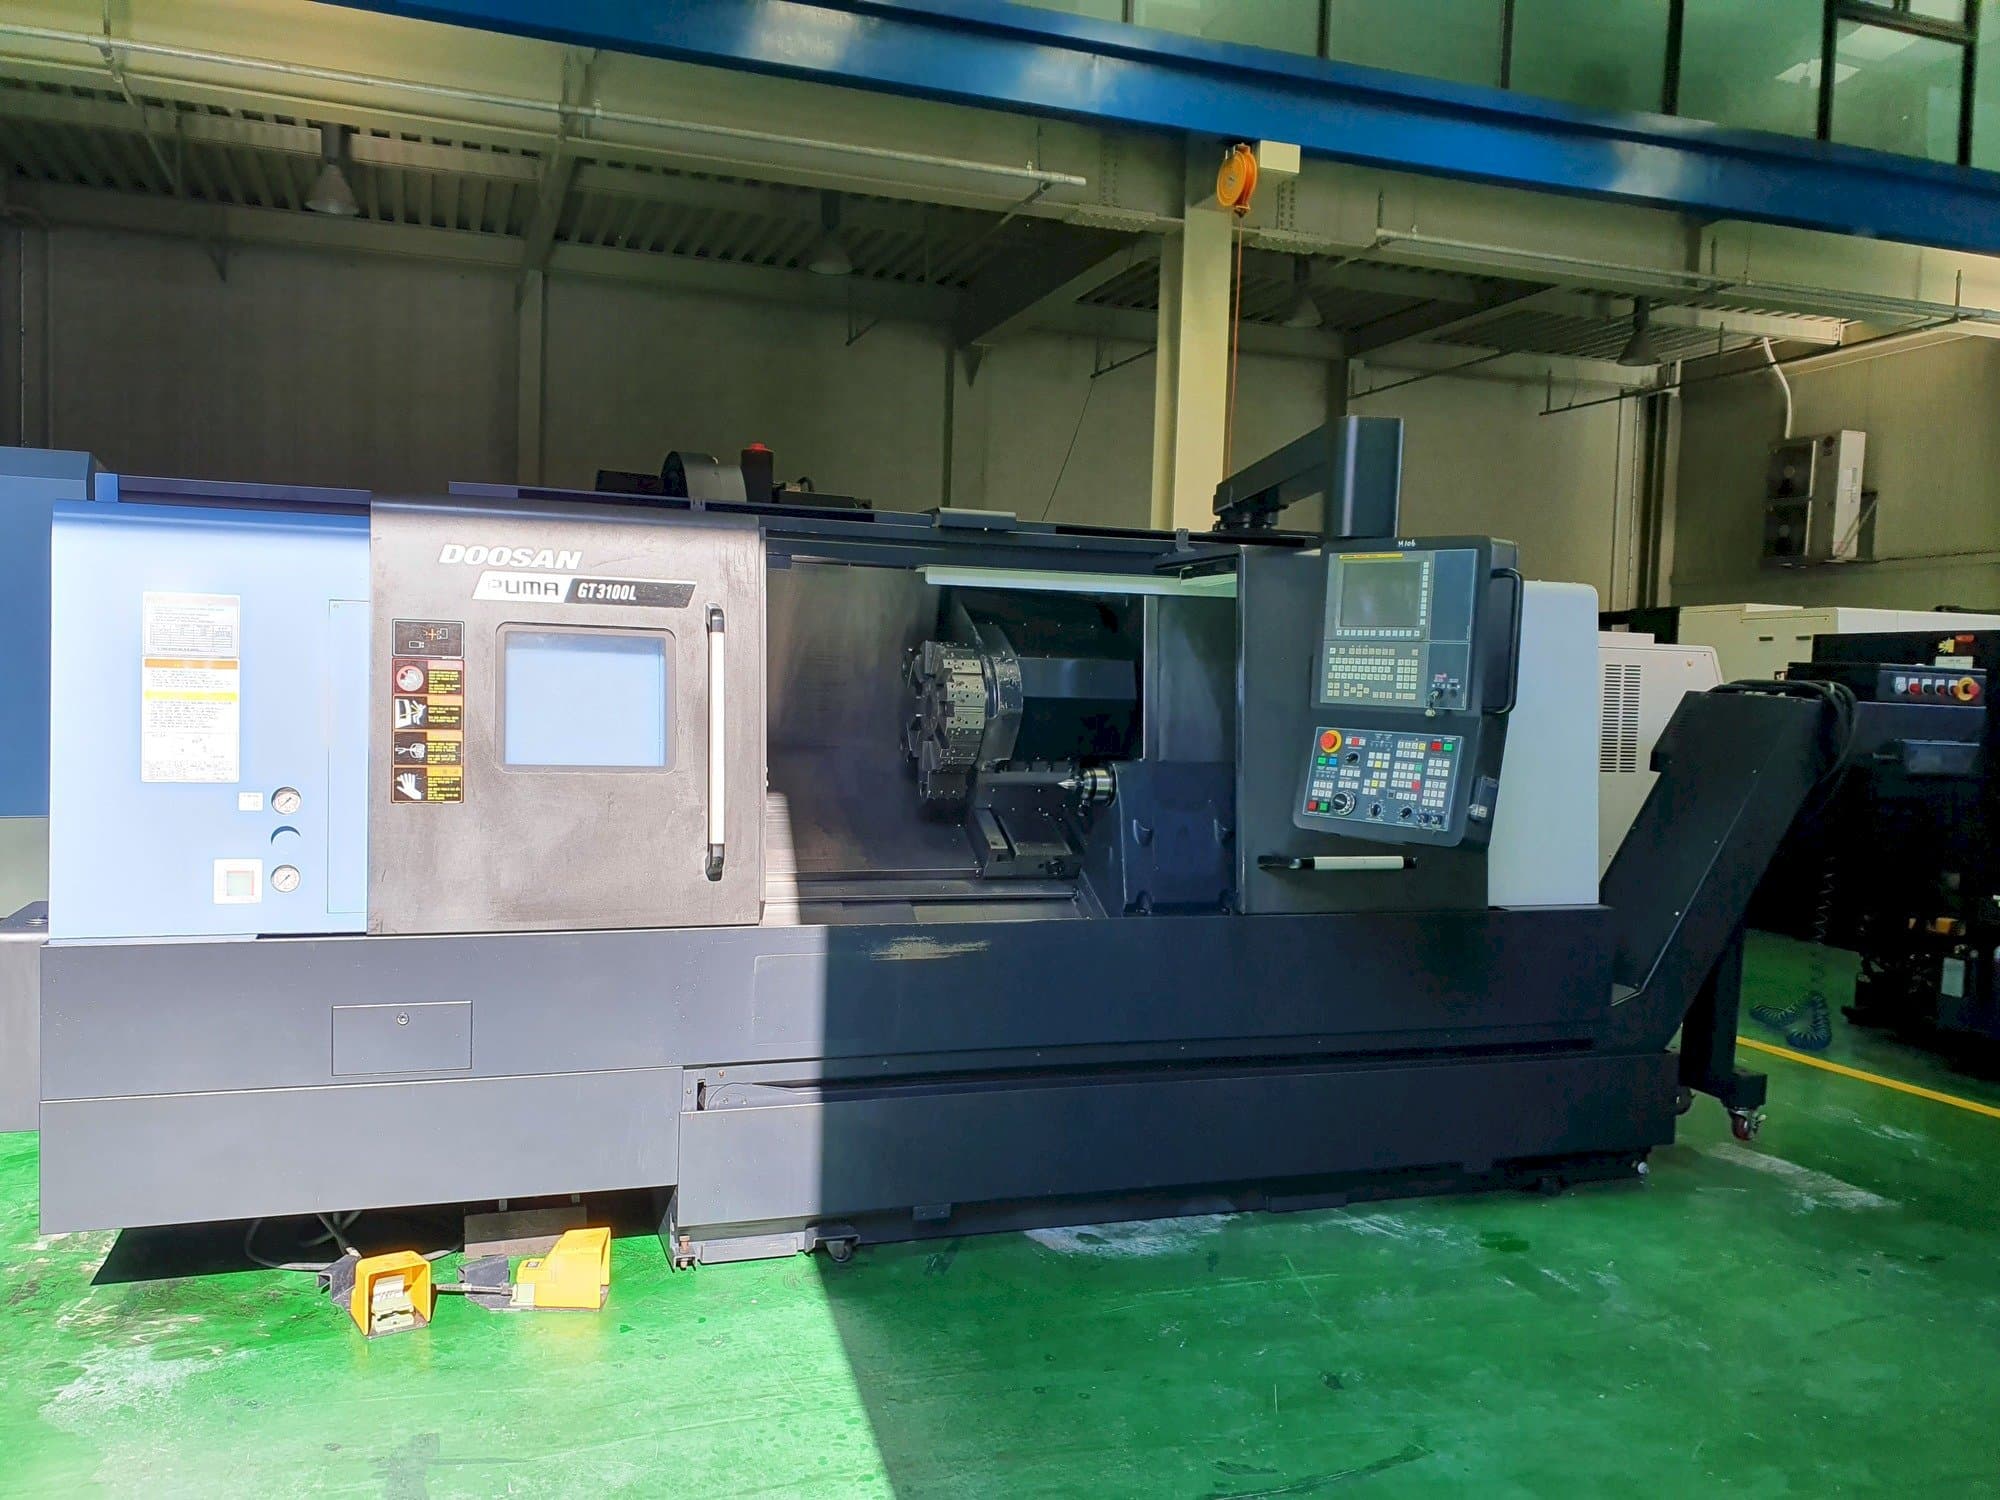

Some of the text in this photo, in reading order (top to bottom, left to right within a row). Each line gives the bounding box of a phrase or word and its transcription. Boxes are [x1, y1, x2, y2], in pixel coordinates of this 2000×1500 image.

[439, 544, 582, 570] DOOSAN
[488, 579, 637, 601] PUMA GT3100L
